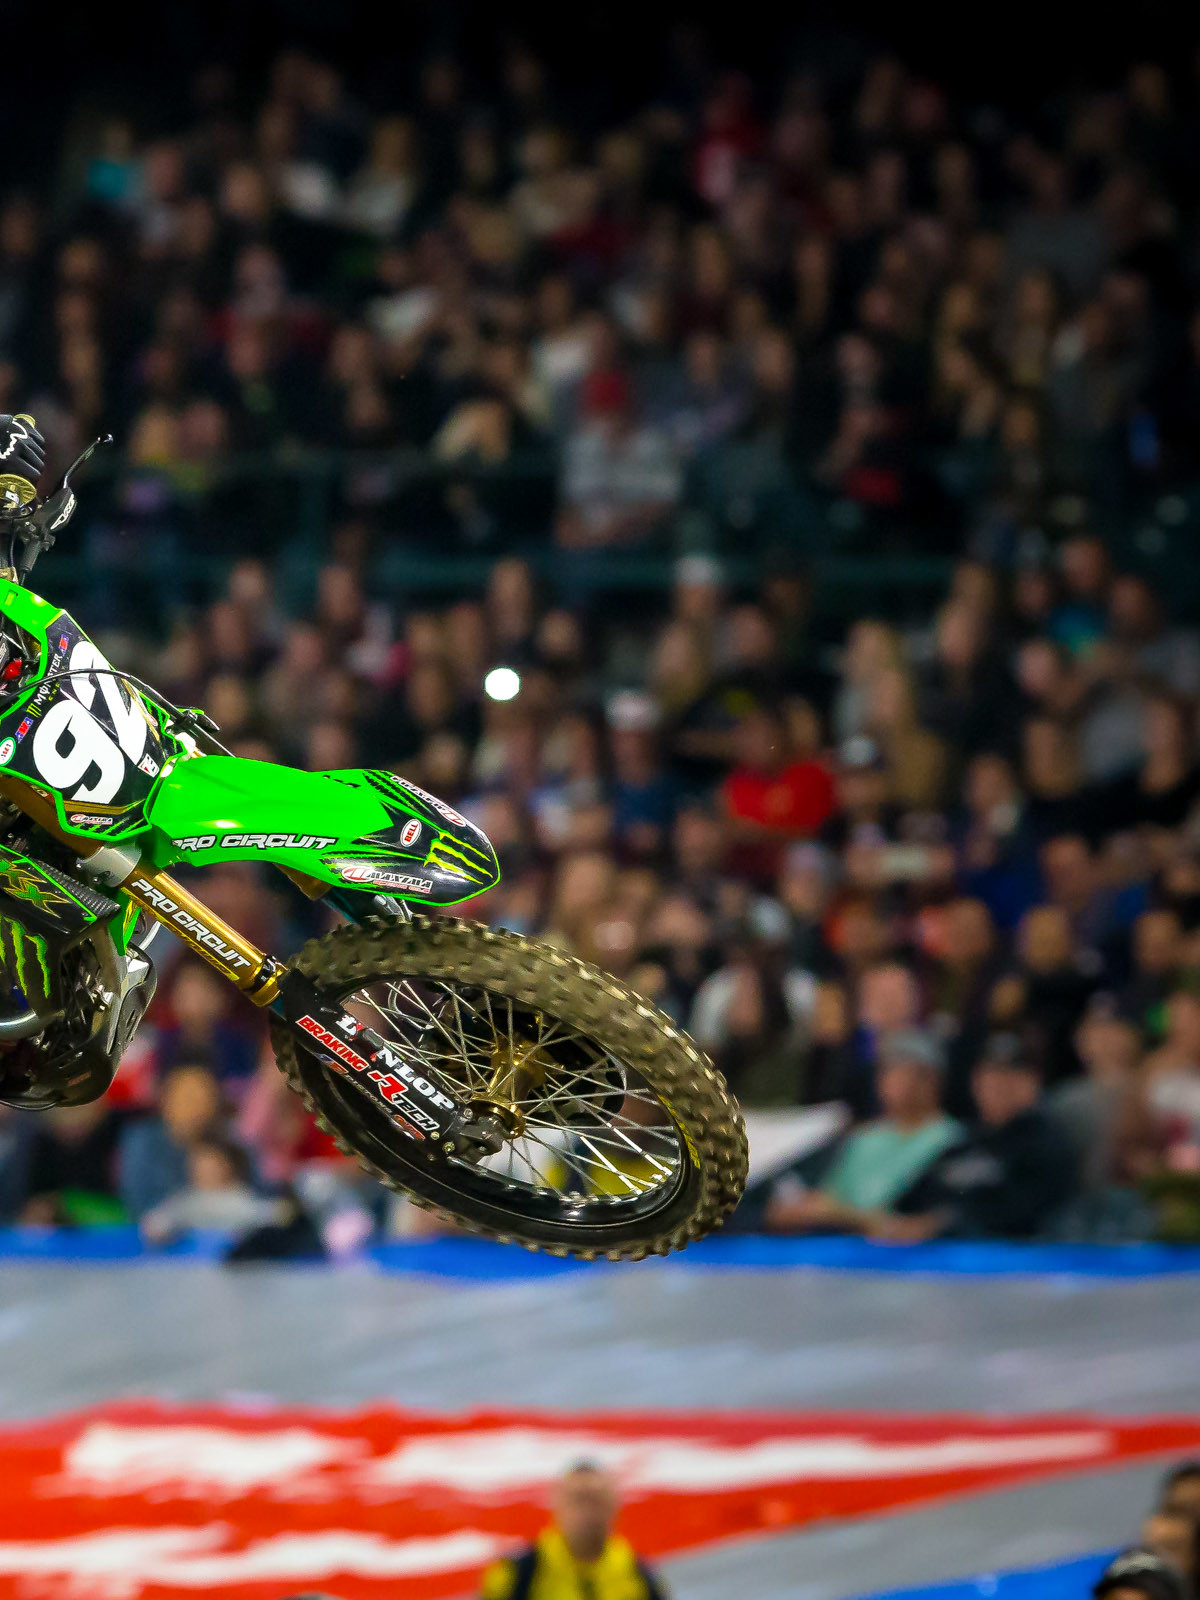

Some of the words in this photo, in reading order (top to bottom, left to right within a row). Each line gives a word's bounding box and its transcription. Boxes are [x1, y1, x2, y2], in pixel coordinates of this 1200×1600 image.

[32, 640, 147, 804] 92
[220, 834, 337, 850] CIRCUIT
[404, 823, 418, 843] BELL
[131, 878, 179, 913] PRO
[172, 910, 252, 968] CIRCUIT
[296, 1015, 370, 1071] BRAKING
